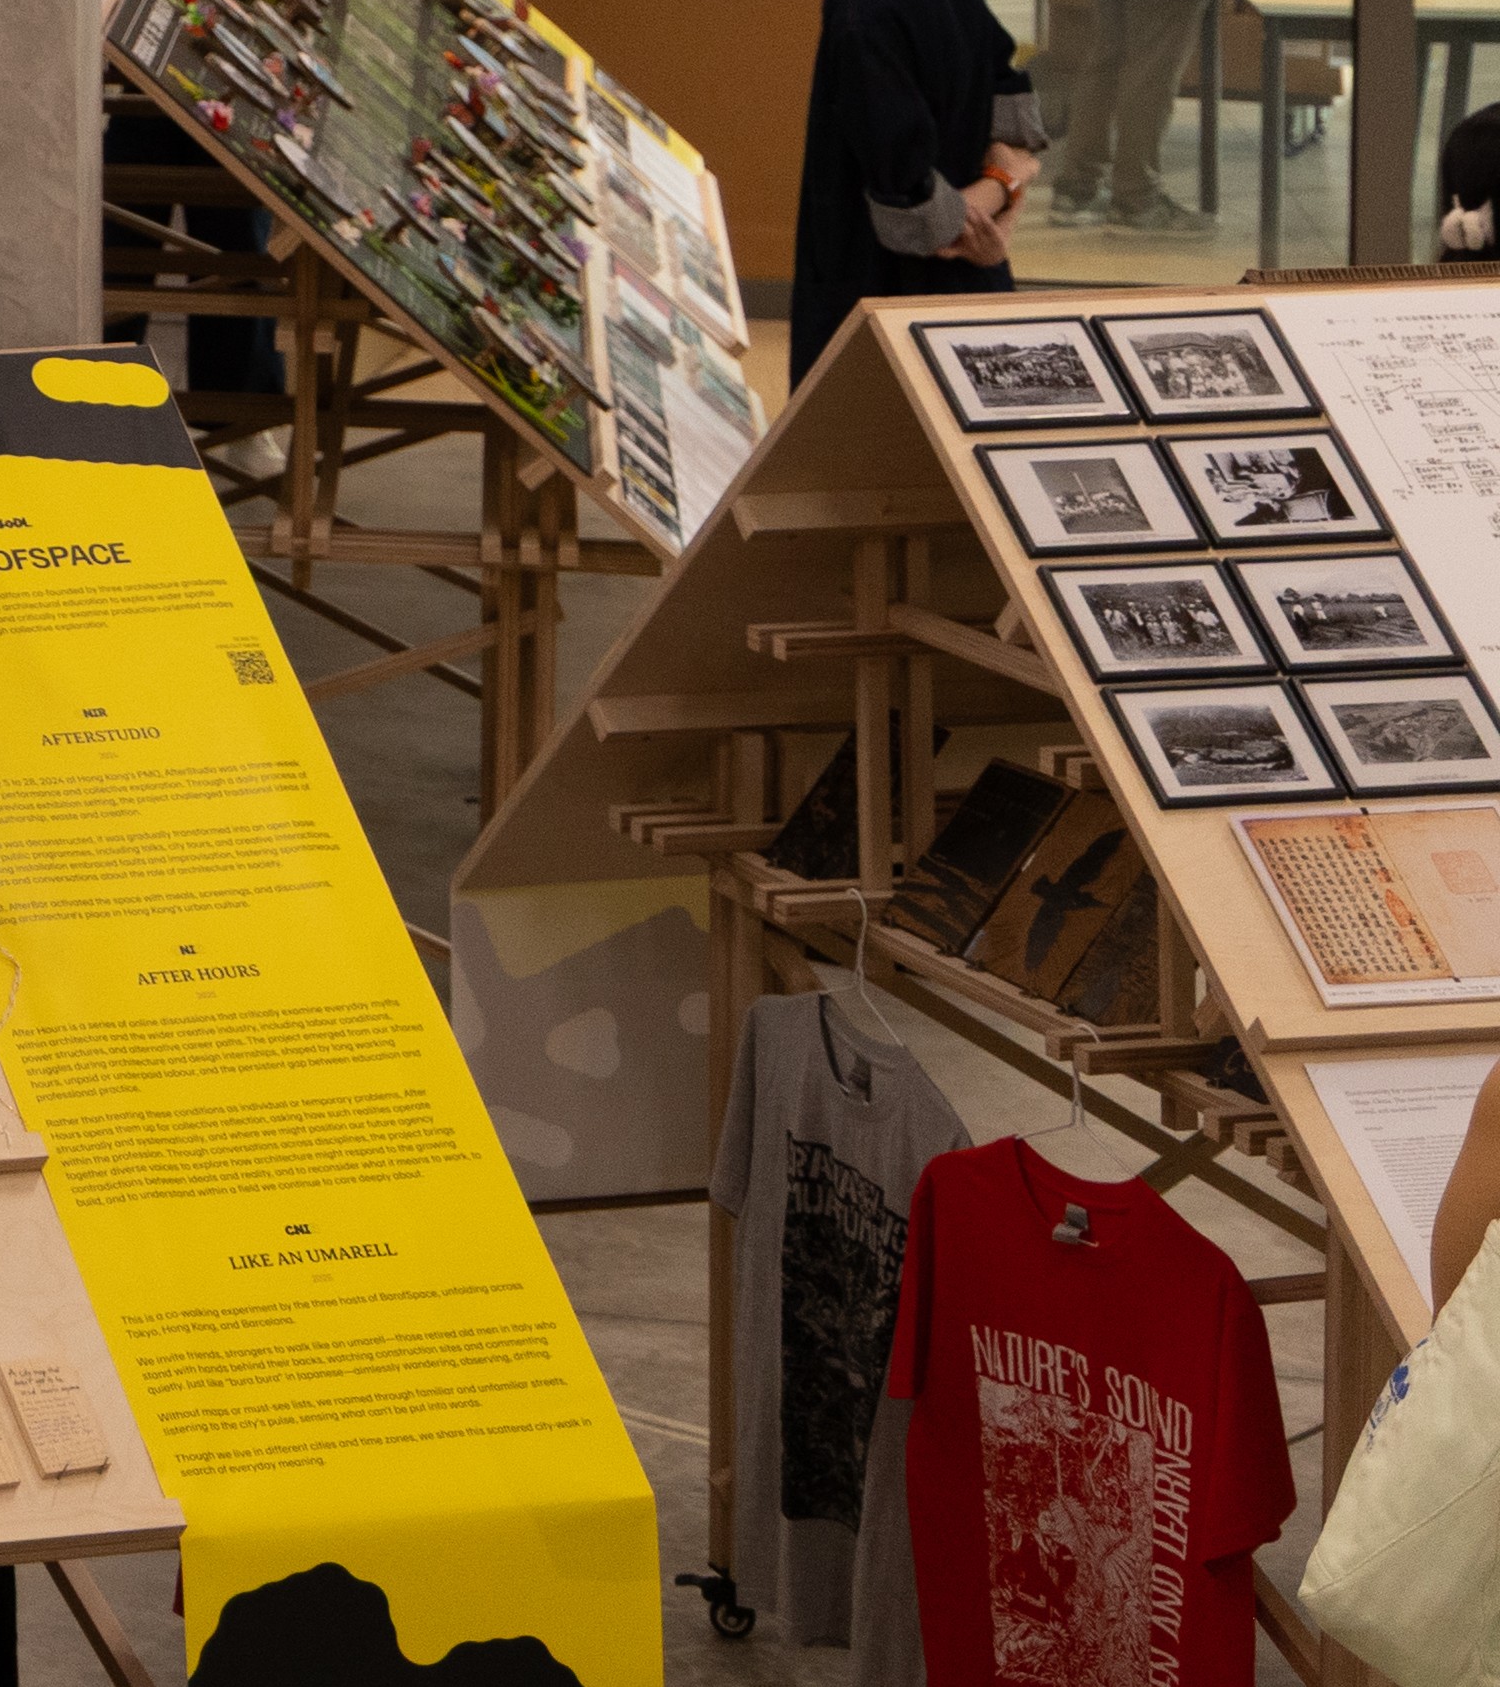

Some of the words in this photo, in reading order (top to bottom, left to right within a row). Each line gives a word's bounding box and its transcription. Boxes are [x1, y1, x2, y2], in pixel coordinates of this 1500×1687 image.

[41, 726, 161, 747] AFTERSTUDIO
[139, 970, 192, 986] AFTER
[199, 963, 261, 981] HOURS
[229, 1253, 274, 1271] LIKE
[279, 1250, 304, 1267] AN
[307, 1242, 398, 1263] UMARELL
[163, 1324, 191, 1336] Hong
[220, 1319, 240, 1330] and
[970, 1324, 1091, 1412] NATURE'S
